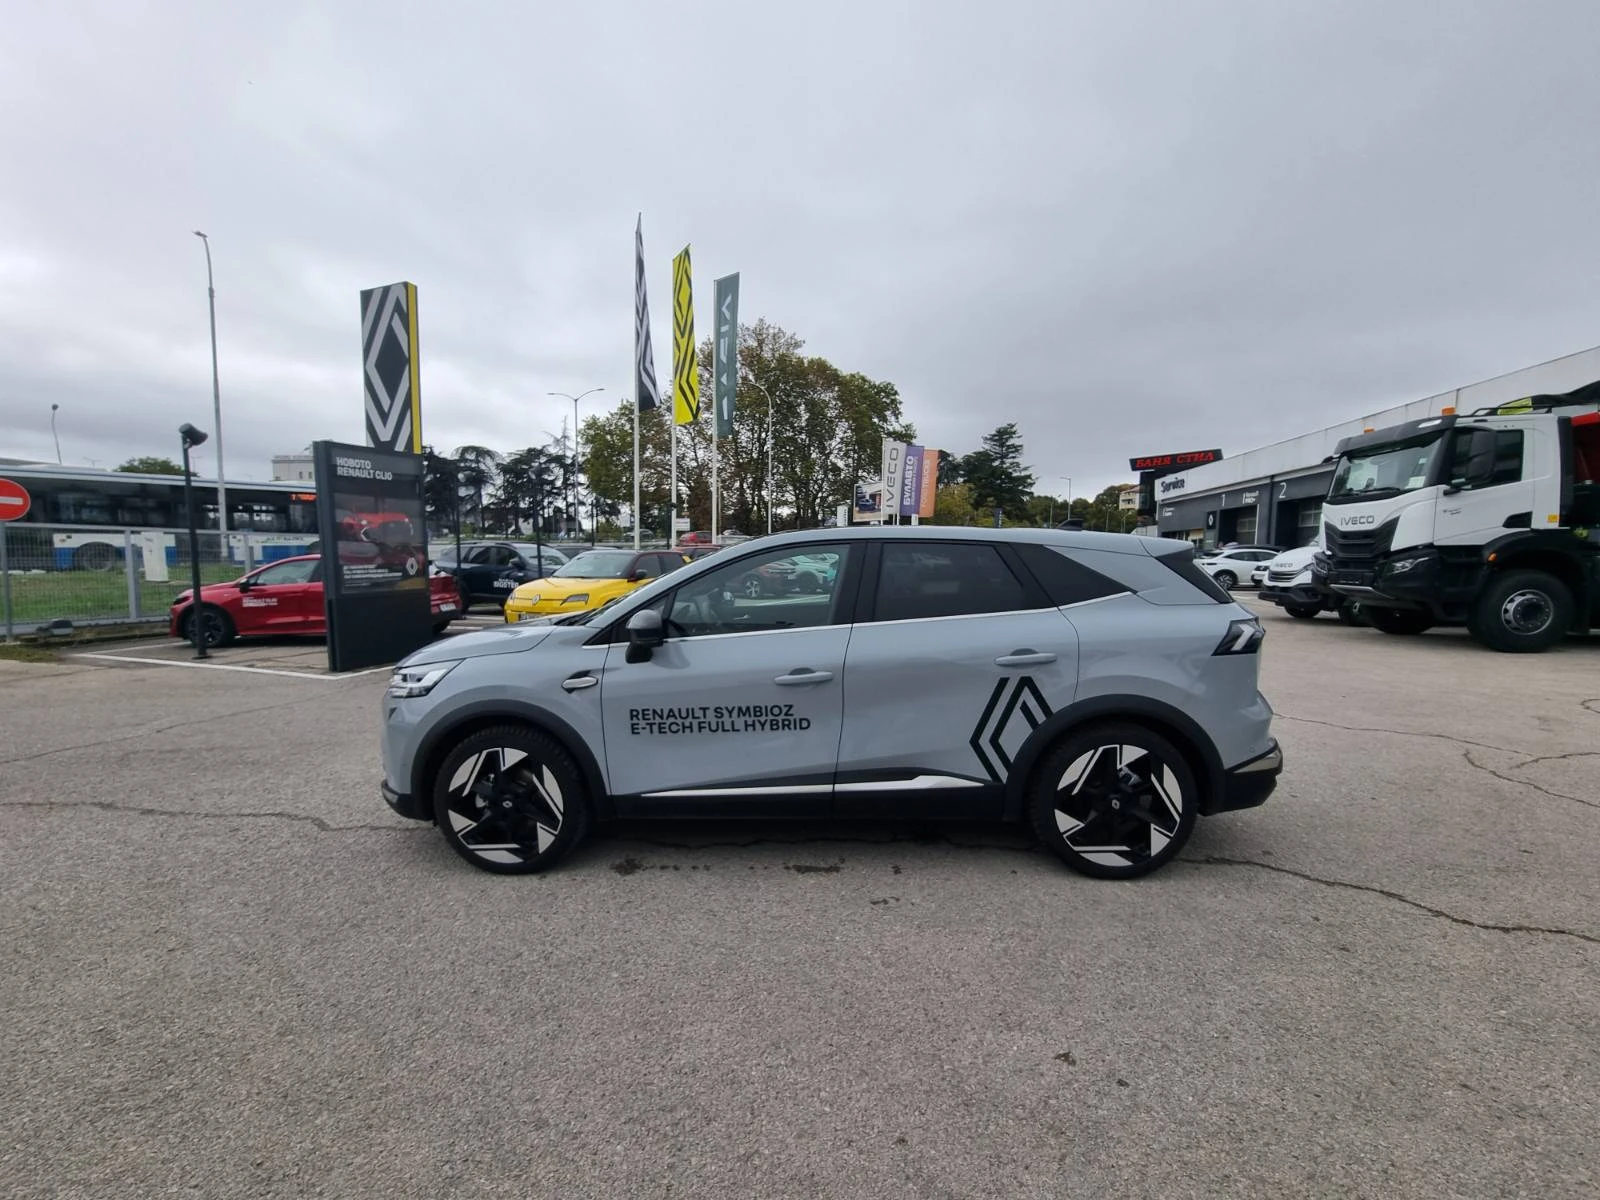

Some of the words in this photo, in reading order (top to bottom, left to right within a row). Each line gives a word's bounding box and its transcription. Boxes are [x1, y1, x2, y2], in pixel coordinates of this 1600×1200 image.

[1136, 457, 1172, 468] БАНЯ
[336, 466, 374, 479] RENAULT
[375, 471, 393, 481] CLIO
[886, 447, 899, 508] IVECO
[1279, 482, 1287, 498] 2
[1221, 494, 1226, 507] 1
[1341, 515, 1375, 526] IVECO
[630, 707, 710, 722] RENAULT
[714, 704, 795, 719] SYMBIOZ
[631, 722, 694, 735] E-TECH
[698, 720, 741, 733] FULL
[744, 718, 812, 732] HYBRID
